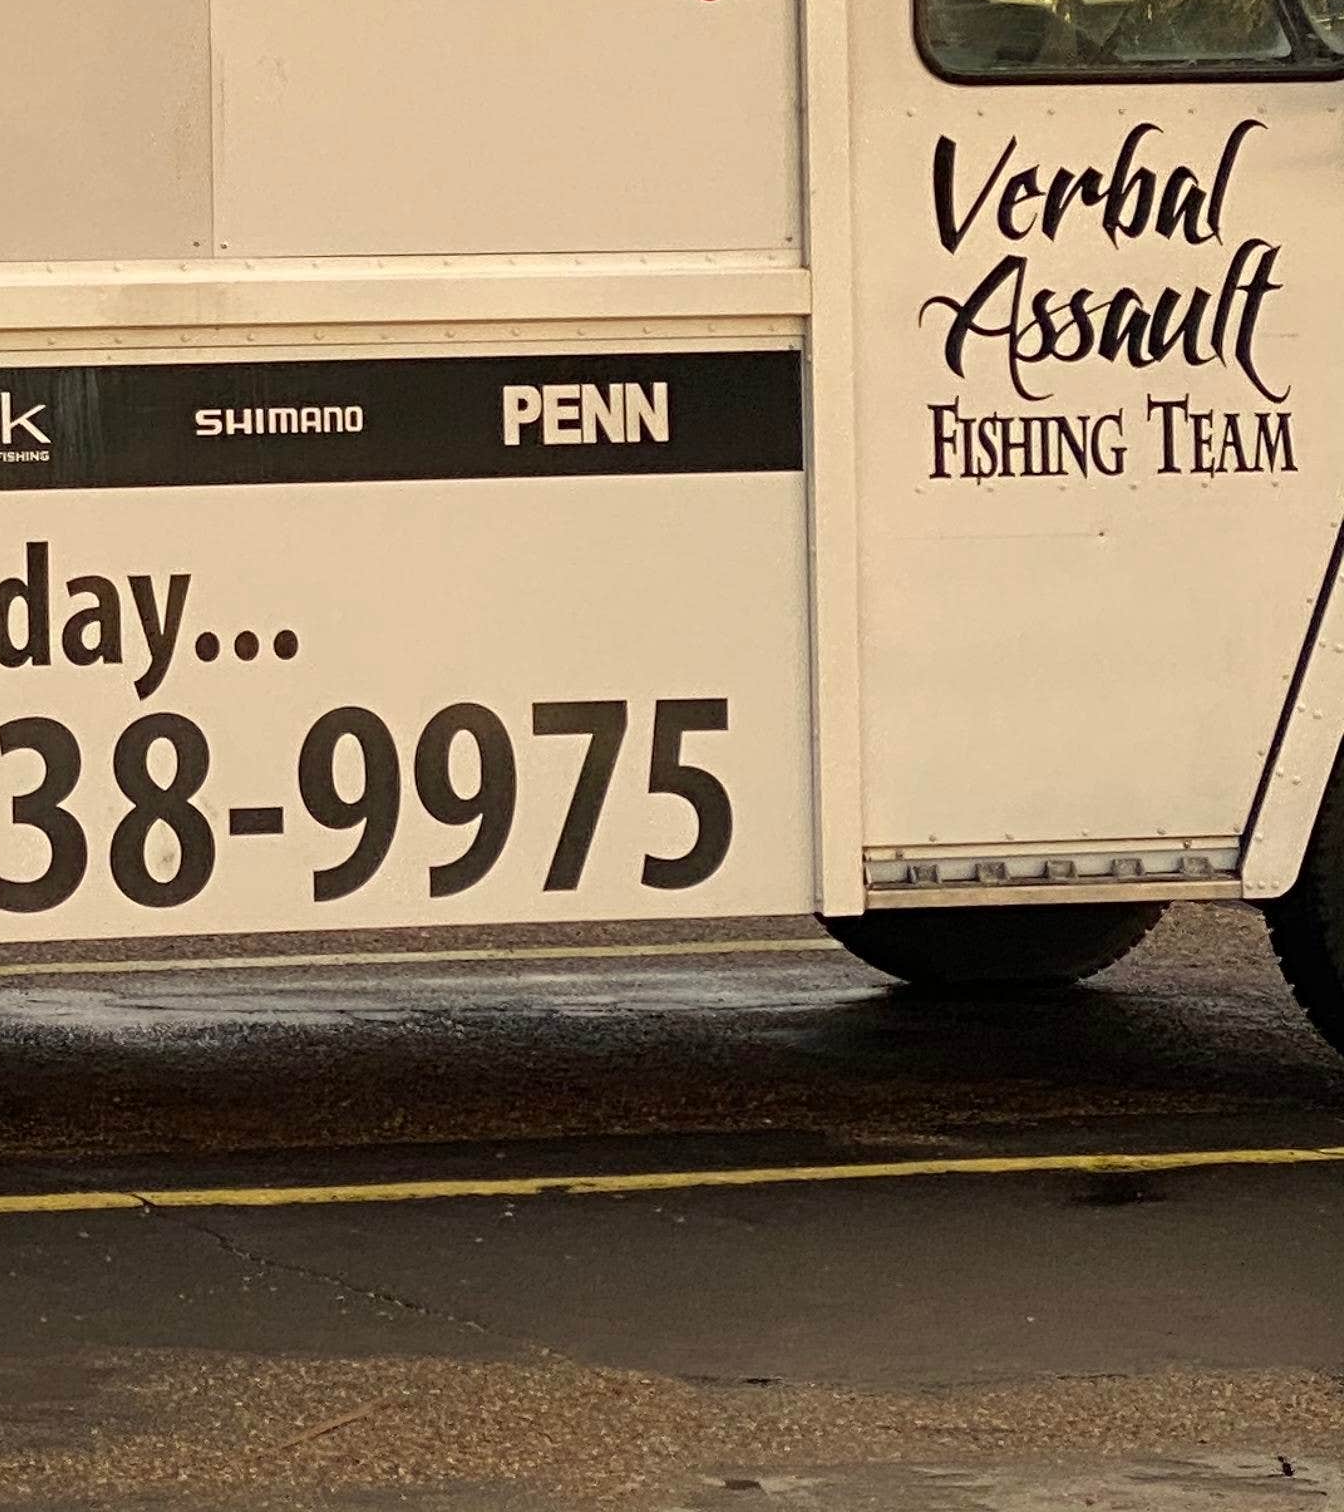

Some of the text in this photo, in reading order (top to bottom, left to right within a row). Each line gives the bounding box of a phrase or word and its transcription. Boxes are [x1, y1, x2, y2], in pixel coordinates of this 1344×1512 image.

[932, 118, 1269, 256] Verbal
[918, 237, 1293, 405] Assault
[195, 405, 364, 436] SHIMANO
[503, 382, 670, 446] PENN
[927, 392, 1298, 485] FISHING TEAM
